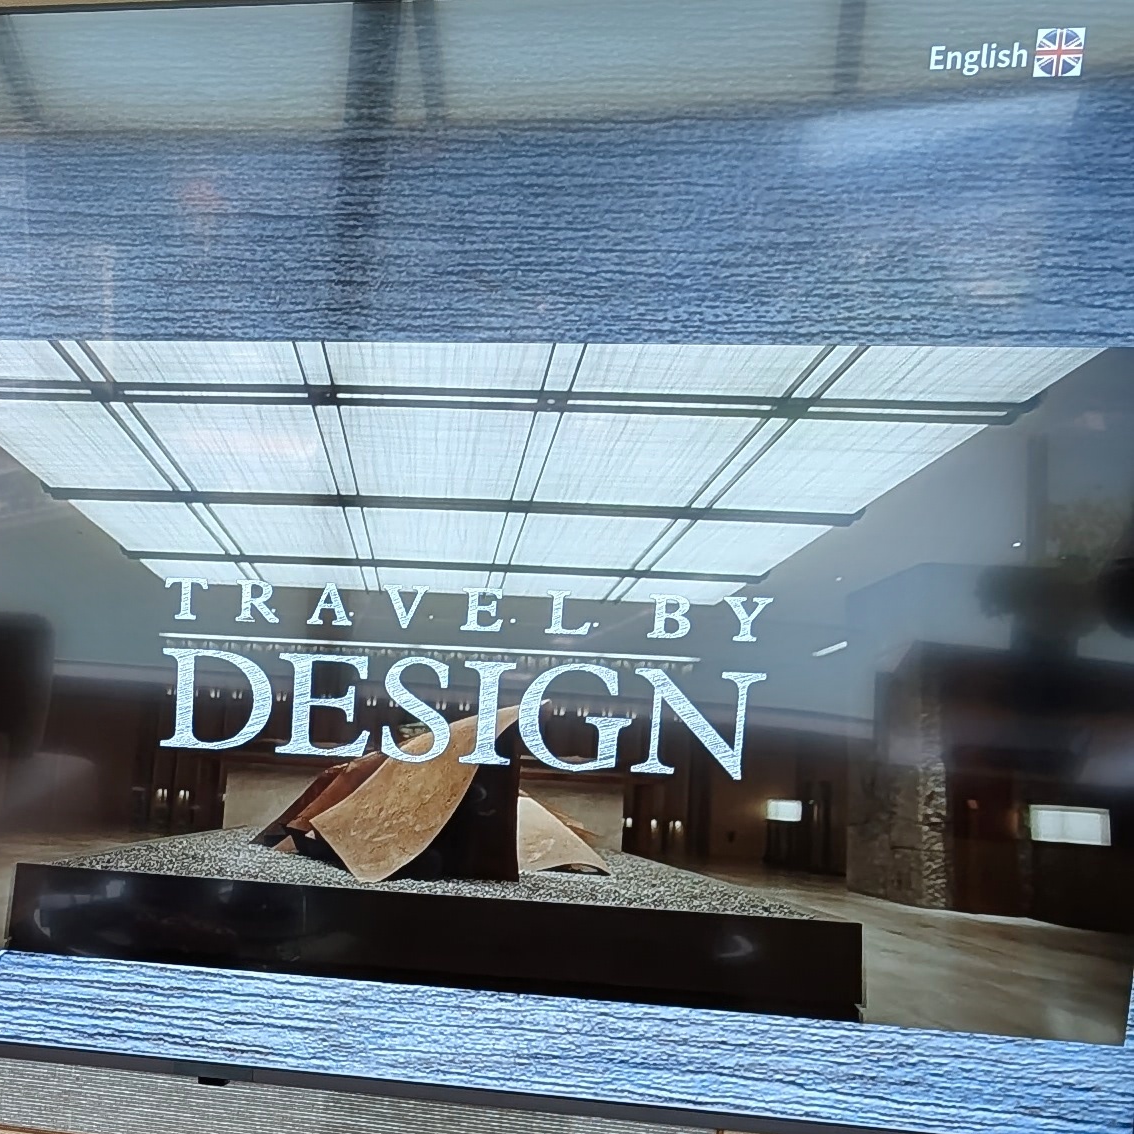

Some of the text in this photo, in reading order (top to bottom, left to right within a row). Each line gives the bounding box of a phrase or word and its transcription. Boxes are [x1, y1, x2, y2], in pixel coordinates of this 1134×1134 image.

[929, 42, 1027, 75] English
[646, 593, 774, 642] BY
[160, 646, 767, 781] DESIGN
